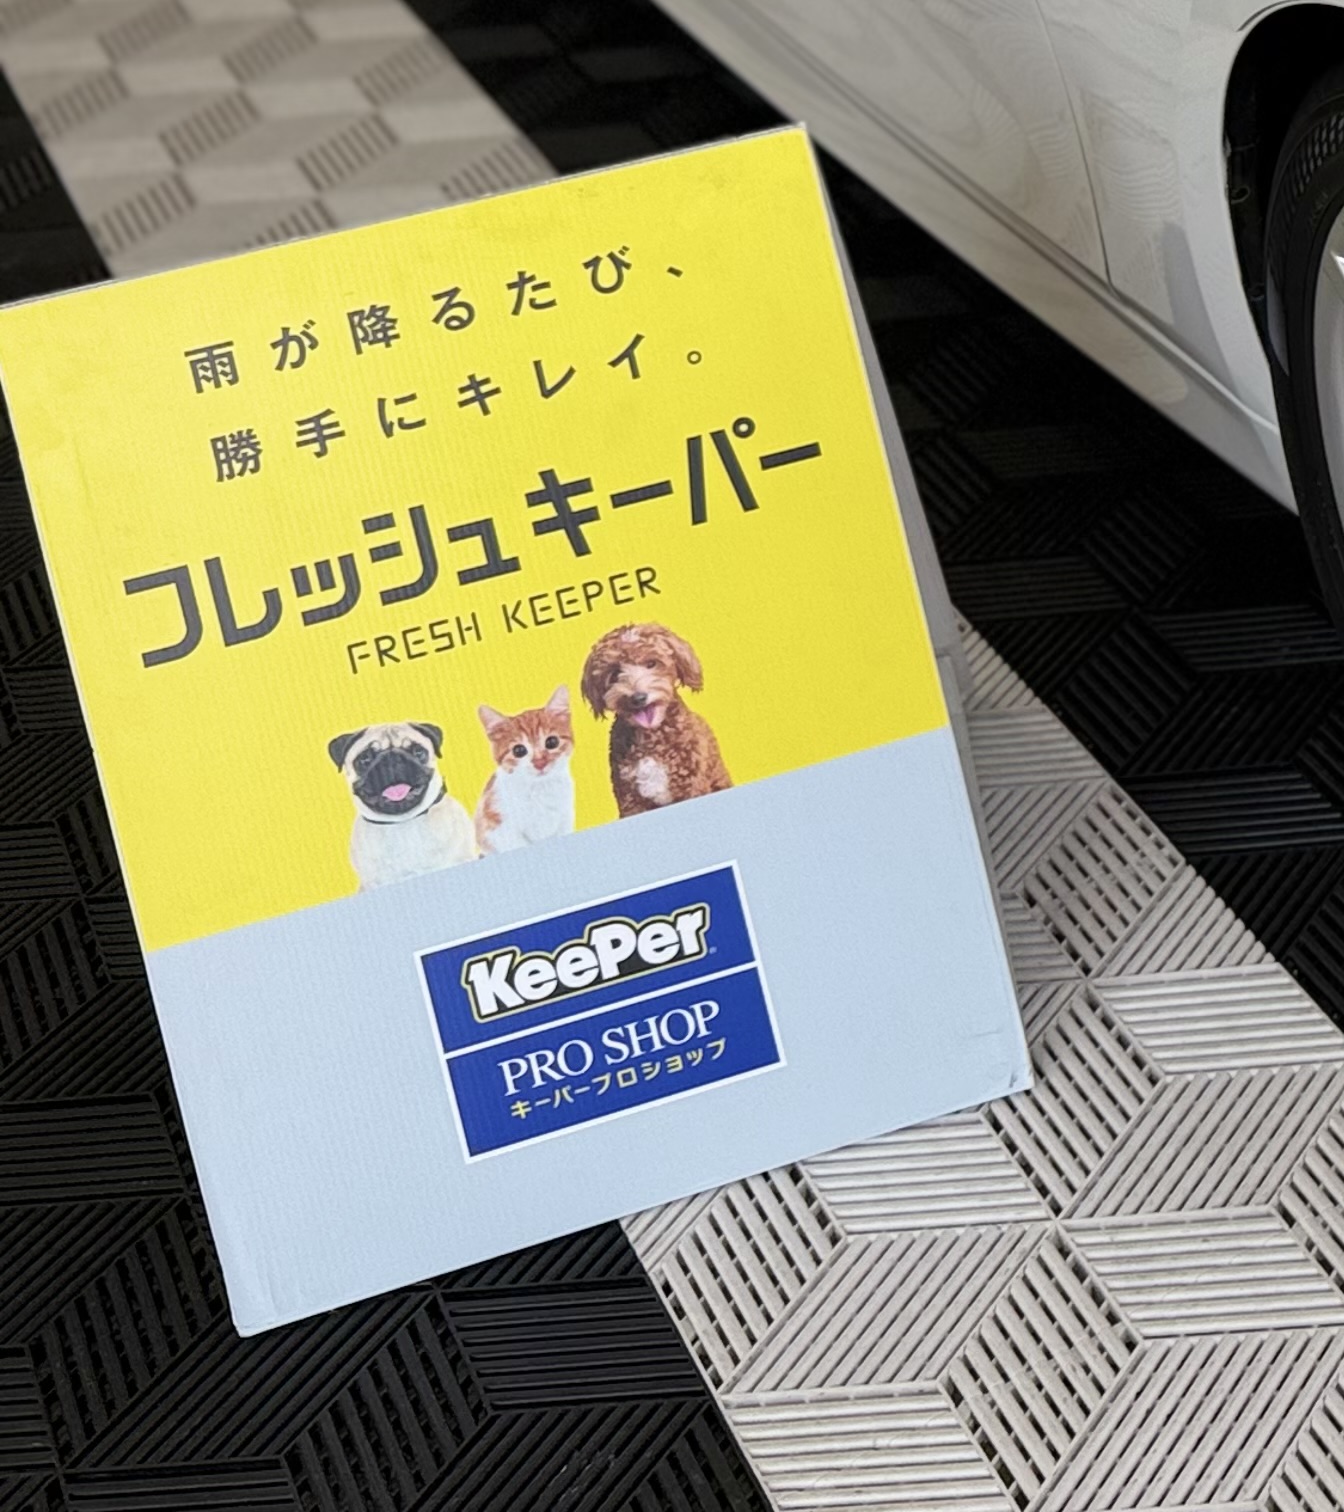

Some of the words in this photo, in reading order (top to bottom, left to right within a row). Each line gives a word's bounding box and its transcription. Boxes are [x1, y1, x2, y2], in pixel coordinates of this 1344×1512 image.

[184, 245, 686, 395] 雨が降るたび、
[209, 333, 704, 484] 勝手にキレイ。
[122, 416, 824, 669] フレッシュキーパー
[347, 611, 483, 675] FRESH
[501, 566, 663, 634] KEEPER
[461, 902, 711, 1024] KeePer
[496, 1038, 595, 1098] PRO
[601, 999, 721, 1066] SHOP
[509, 1036, 728, 1120] キーパープロショップ
